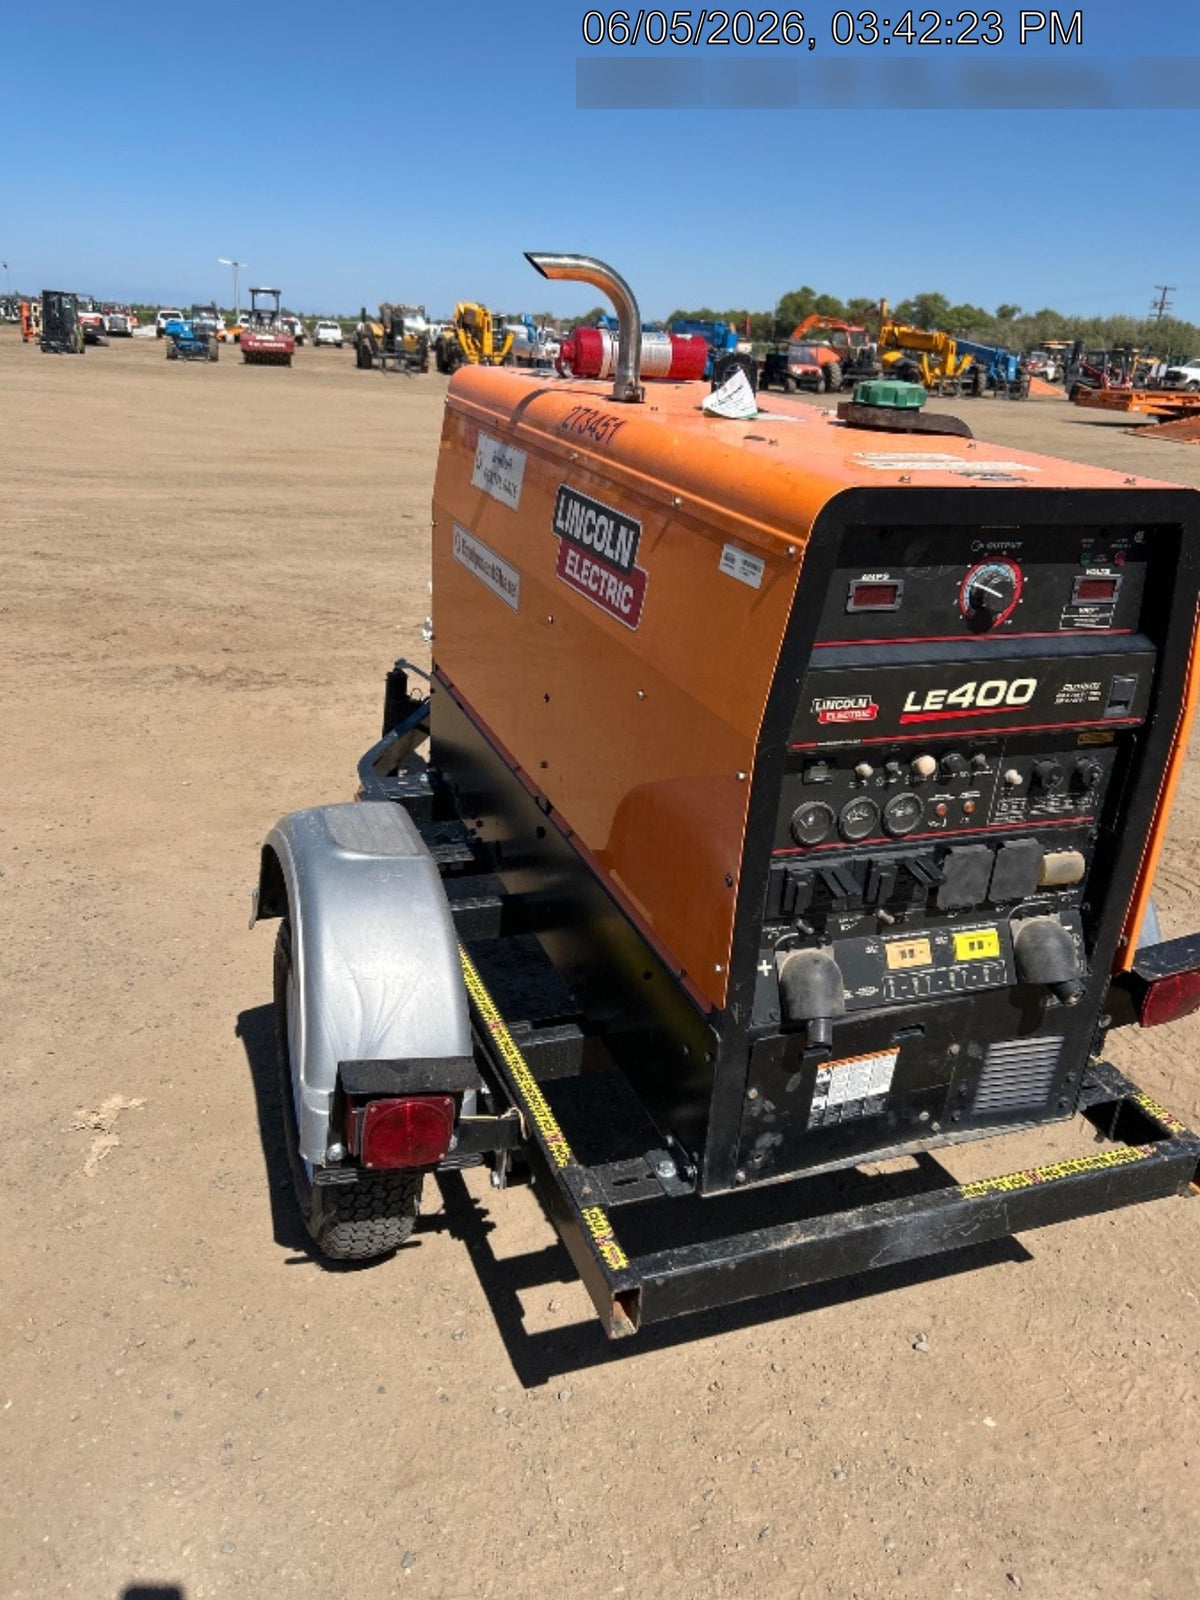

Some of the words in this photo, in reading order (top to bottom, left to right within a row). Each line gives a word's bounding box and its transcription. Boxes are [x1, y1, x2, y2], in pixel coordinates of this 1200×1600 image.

[555, 494, 637, 568] LINCOLN
[564, 548, 634, 615] ELECTRIC
[815, 698, 868, 711] LINCOLN
[902, 678, 1038, 712] LE400
